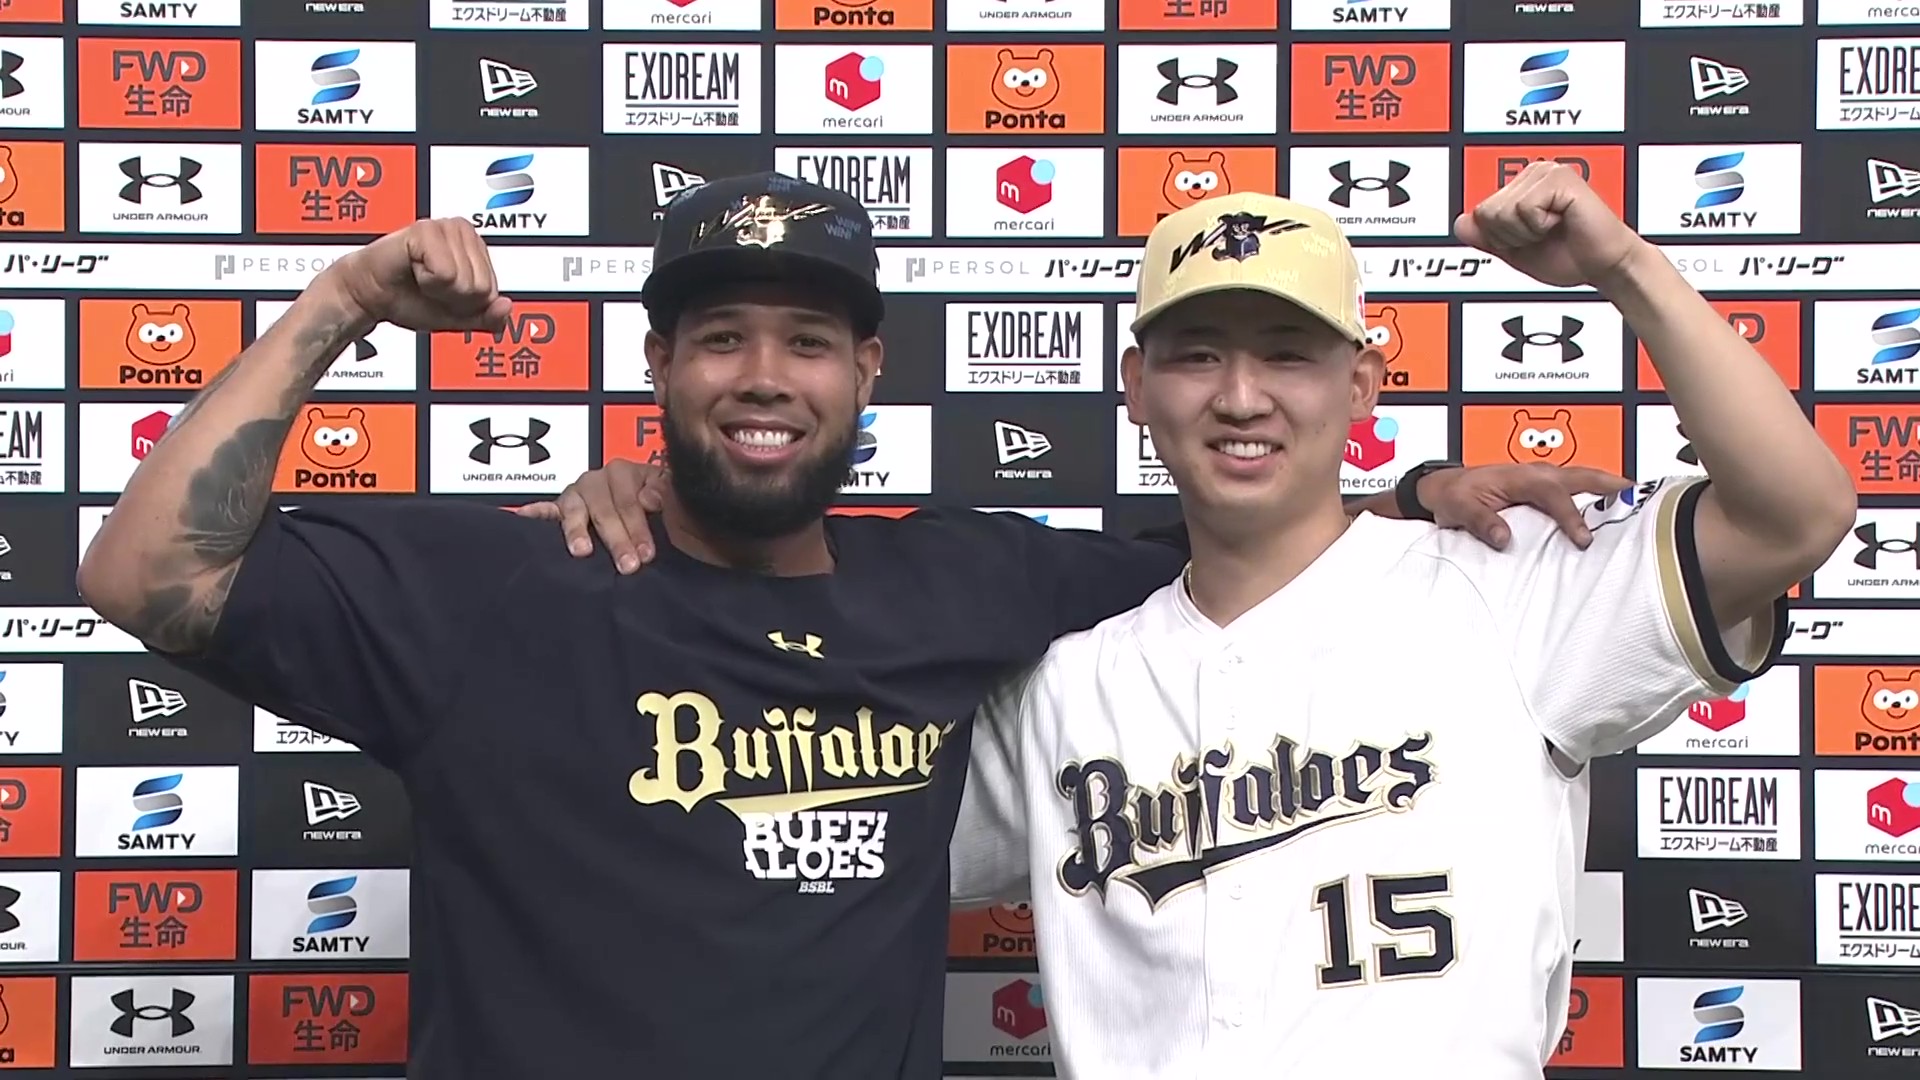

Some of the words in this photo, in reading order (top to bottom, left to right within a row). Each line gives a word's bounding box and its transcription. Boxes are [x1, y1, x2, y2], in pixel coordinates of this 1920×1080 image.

[120, 3, 197, 18] SAMTY
[452, 7, 566, 22] エクスドリーム不動産
[651, 12, 711, 24] mercari
[814, 7, 894, 26] Ponta
[1333, 7, 1408, 22] SAMTY
[1663, 4, 1780, 19] エクスドリーム不動産
[113, 50, 206, 82] FWD
[1325, 55, 1416, 86] FWD
[625, 52, 739, 100] EXDREAM
[124, 84, 192, 117] 生命
[1336, 88, 1402, 120] 生命
[298, 109, 373, 124] SAMTY
[625, 112, 739, 126] エクスドリーム不動産
[823, 116, 883, 128] mercari
[985, 110, 1066, 129] Ponta
[1151, 114, 1191, 122] UNDER
[1194, 114, 1243, 122] ARMOUR
[1506, 109, 1582, 125] SAMTY
[290, 156, 382, 188] FWD
[1498, 157, 1590, 190] FD
[301, 190, 368, 222] 生命
[113, 213, 153, 221] UNDER
[157, 213, 208, 221] ARMOUR
[472, 213, 547, 229] SAMTY
[870, 215, 911, 230] 不動産
[994, 218, 1054, 230] mercari
[1680, 212, 1757, 228] SAMTY
[243, 258, 335, 272] PERSO
[933, 260, 1029, 274] PERSOL
[464, 313, 556, 344] WD
[968, 311, 1081, 358] EXDREAM
[476, 347, 541, 378] 生命
[119, 365, 202, 384] Ponta
[332, 370, 383, 378] ARMOUR
[968, 371, 1081, 384] エクスドリーム不動産
[295, 470, 376, 488] Ponta
[1139, 473, 1176, 486] エクス
[1686, 736, 1748, 748] mercari
[629, 690, 956, 813] Buffaloe
[1660, 777, 1777, 825] EXDREAM
[1056, 730, 1442, 908] Buffaloes
[118, 834, 196, 850] SAMTY
[1660, 837, 1777, 851] エクスドリーム不動産
[799, 881, 834, 893] BSBL
[109, 882, 202, 913] FWD
[119, 916, 188, 949] 生命
[1311, 867, 1460, 990] 15
[293, 937, 369, 952] SAMTY
[282, 985, 375, 1017] FWD
[293, 1020, 360, 1052] 生命
[104, 1045, 146, 1054] UNDER
[148, 1045, 200, 1054] ARMOUR
[1680, 1047, 1757, 1062] SAMTY
